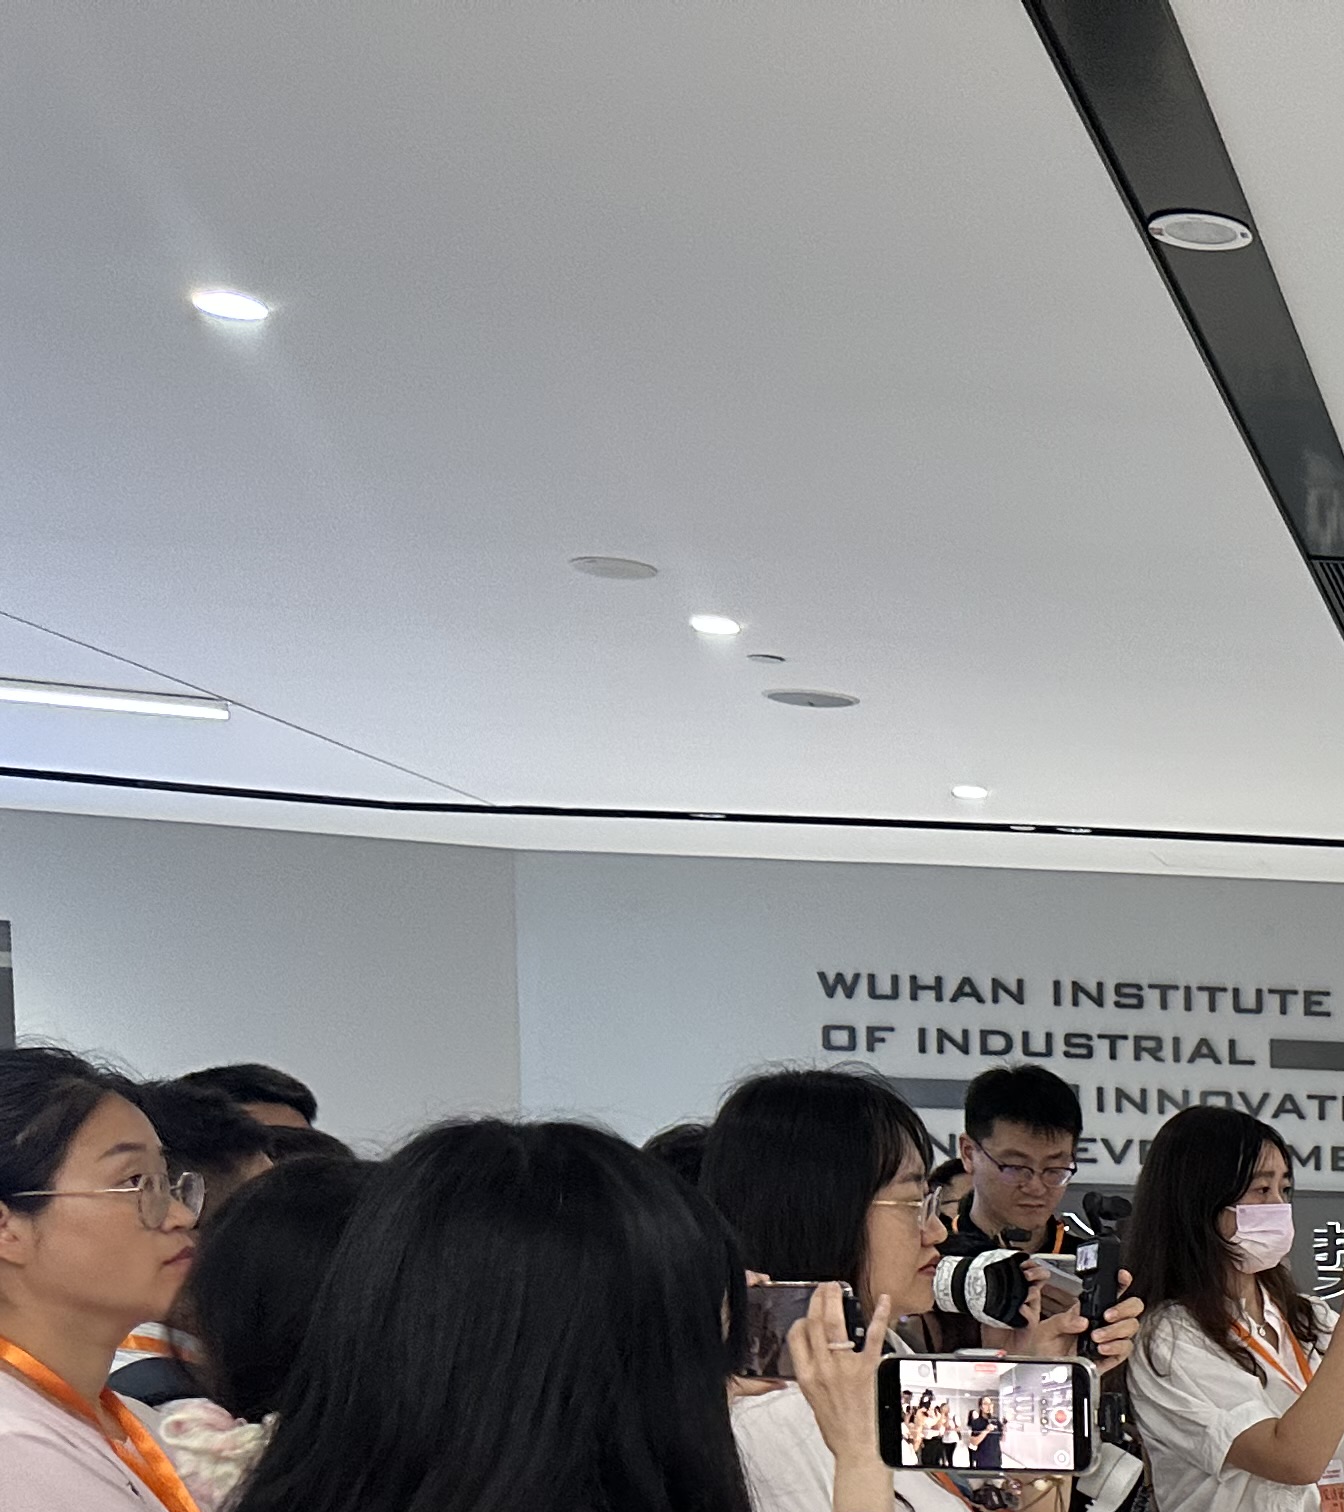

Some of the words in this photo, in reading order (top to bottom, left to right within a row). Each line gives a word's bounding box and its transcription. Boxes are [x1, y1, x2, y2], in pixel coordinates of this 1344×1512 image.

[816, 971, 1025, 1006] WUHAN
[1052, 979, 1332, 1019] INSTITUTE
[821, 1024, 896, 1053] OF
[917, 1026, 1256, 1066] INDUSTRIAL
